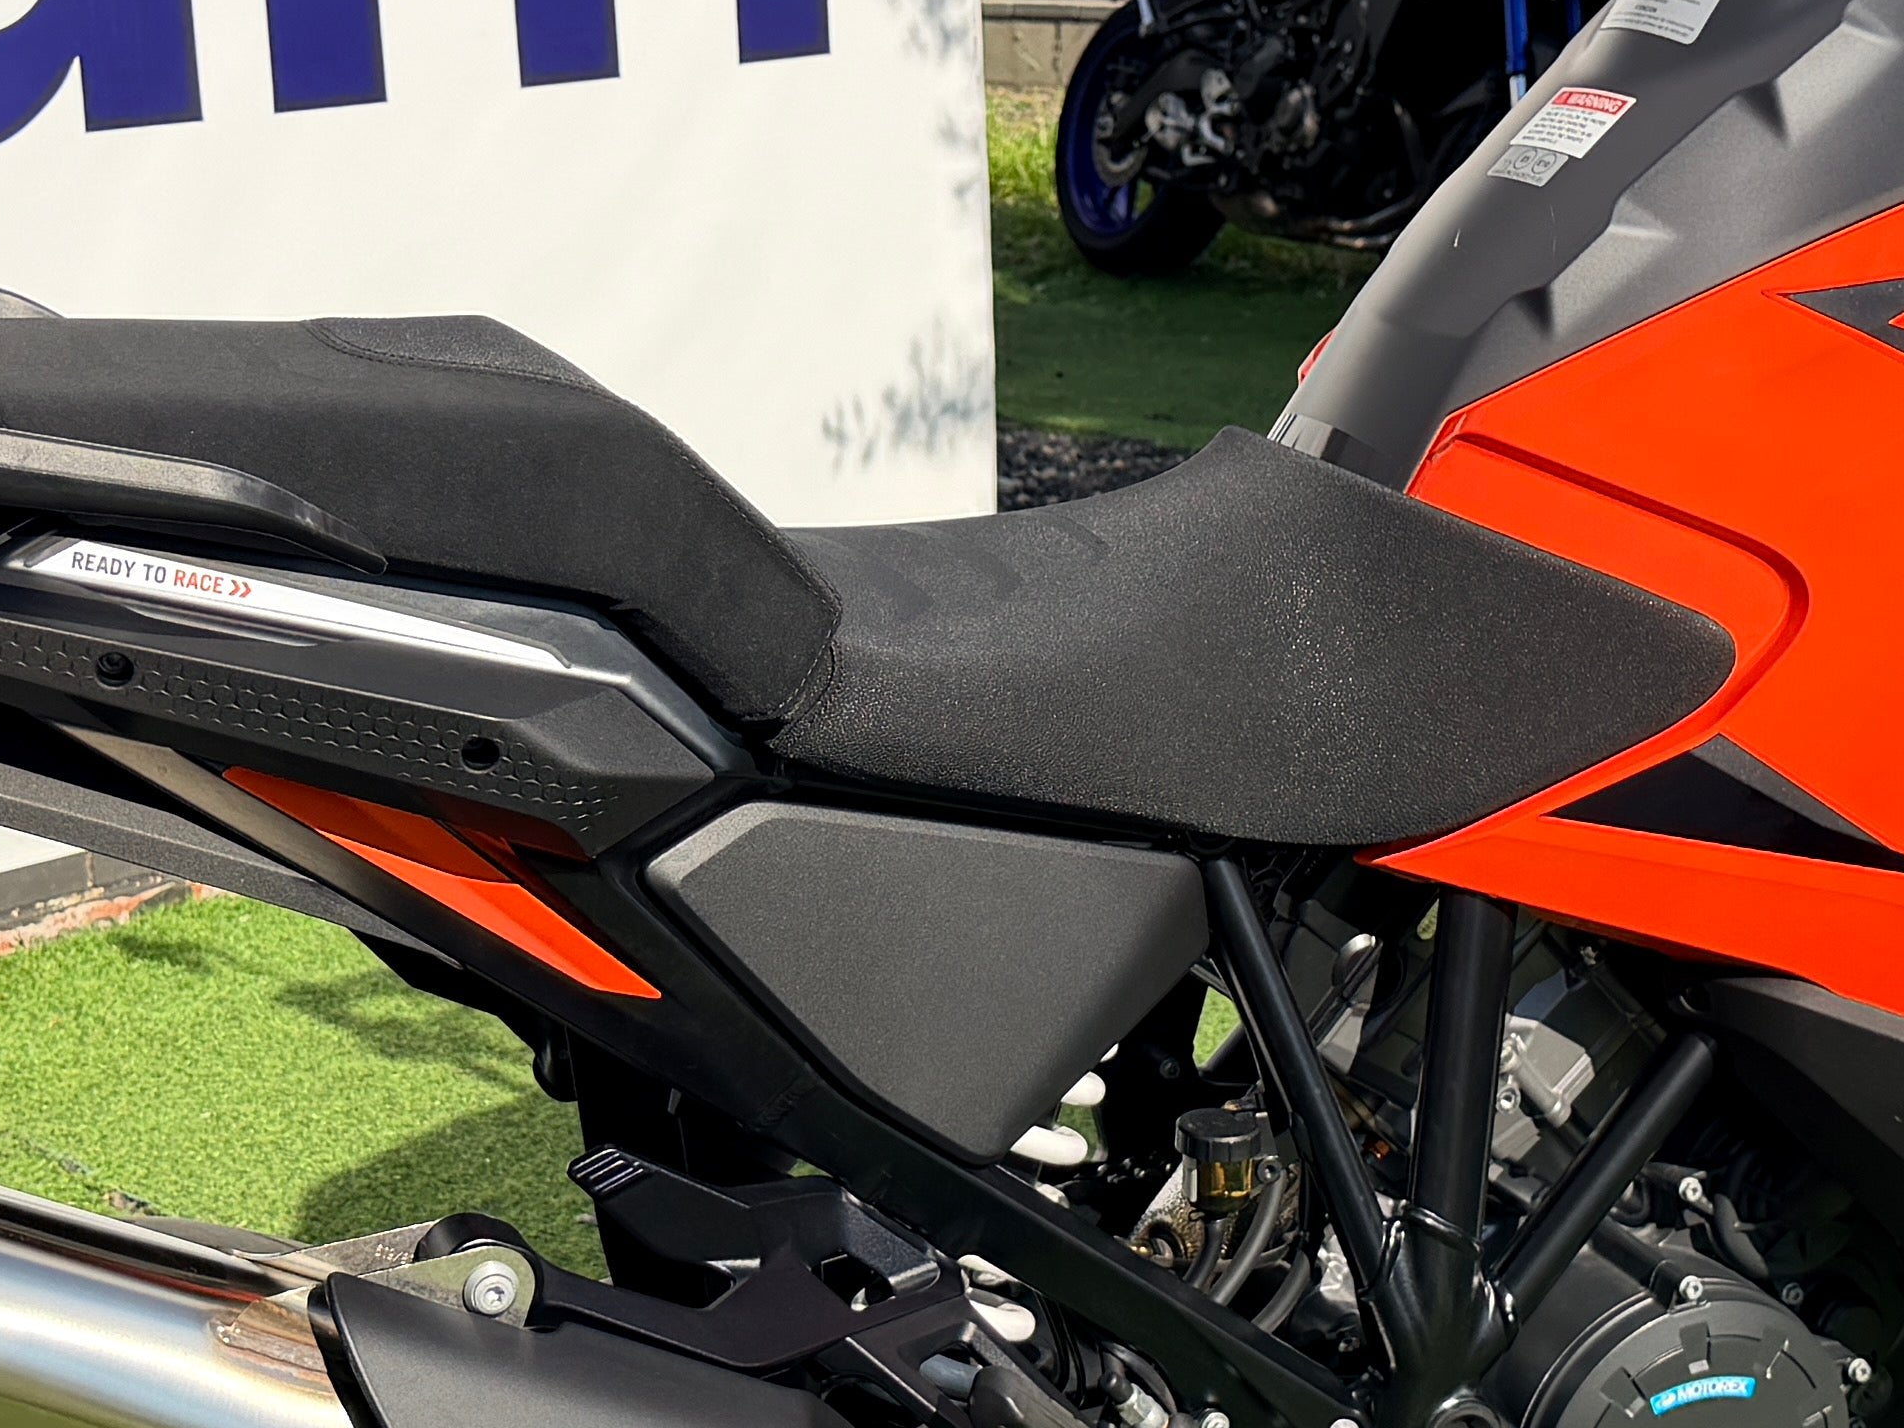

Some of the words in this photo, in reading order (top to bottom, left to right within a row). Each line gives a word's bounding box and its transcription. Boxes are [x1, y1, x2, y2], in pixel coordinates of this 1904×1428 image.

[1567, 92, 1623, 113] WARNING
[72, 551, 136, 580] READY
[143, 563, 167, 585] TO
[173, 569, 224, 596] RACE
